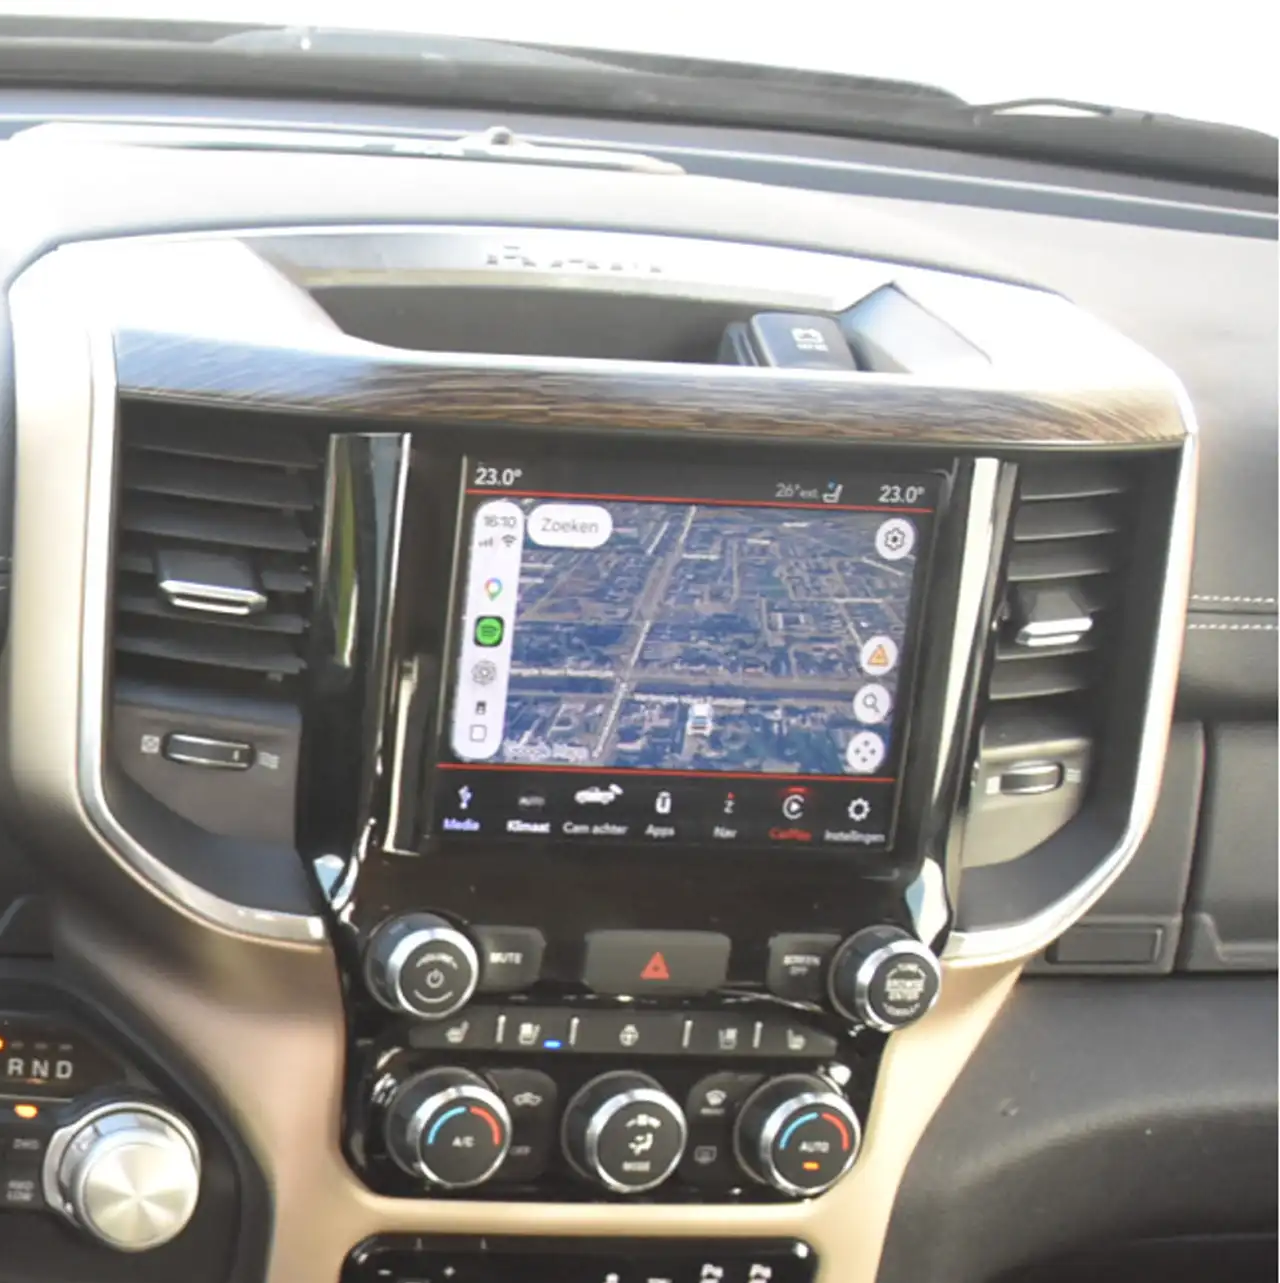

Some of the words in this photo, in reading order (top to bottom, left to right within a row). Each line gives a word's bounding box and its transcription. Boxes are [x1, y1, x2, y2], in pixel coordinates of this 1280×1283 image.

[540, 517, 599, 534] Zoeken
[489, 952, 523, 965] MUTE
[783, 954, 821, 967] SCREEN
[7, 1058, 24, 1076] R
[32, 1060, 50, 1078] N
[55, 1060, 74, 1080] D
[800, 1141, 830, 1153] AUTO
